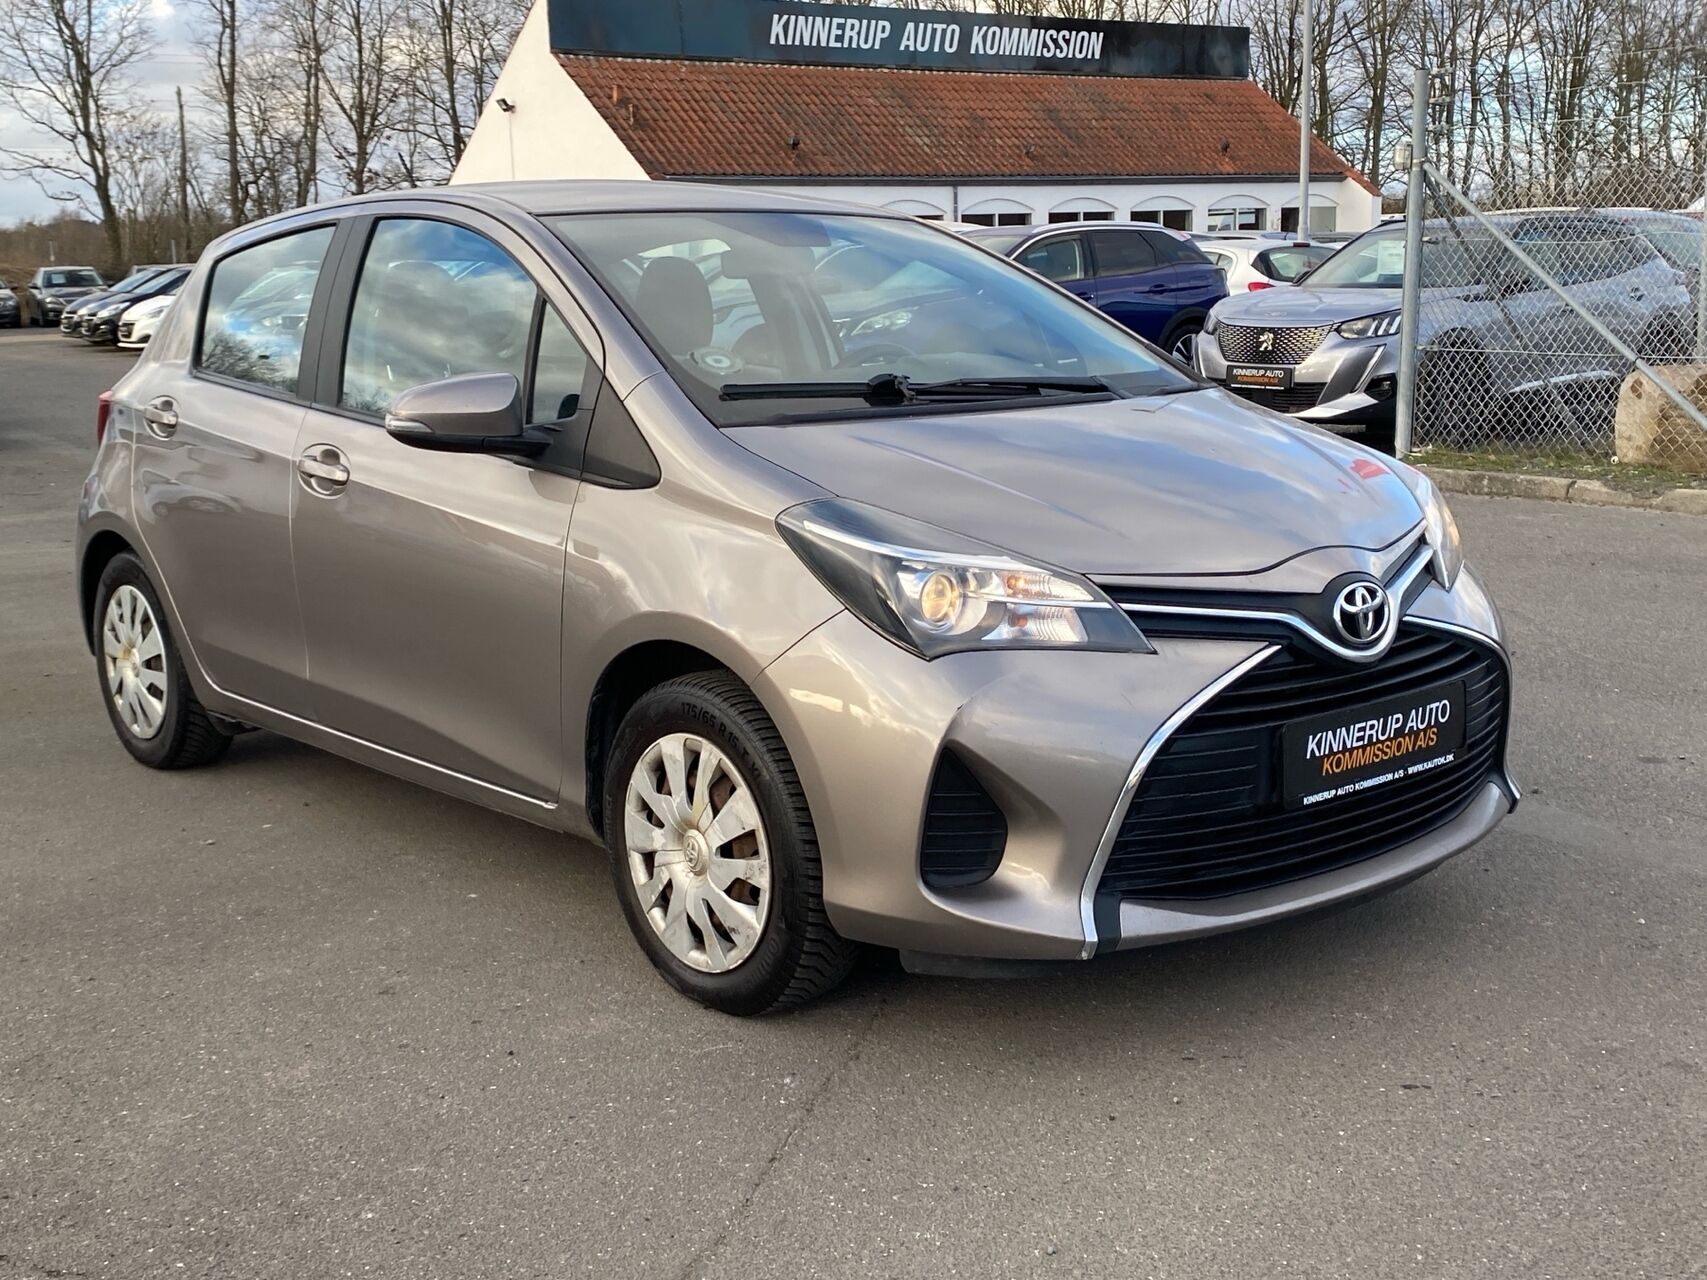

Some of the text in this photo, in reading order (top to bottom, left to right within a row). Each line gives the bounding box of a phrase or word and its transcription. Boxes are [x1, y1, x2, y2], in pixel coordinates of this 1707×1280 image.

[769, 14, 1105, 60] KINNERUP AUTO KOMMISSION
[1265, 370, 1284, 378] AUTO
[680, 702, 716, 728] 175/65
[719, 722, 727, 737] R
[728, 732, 739, 748] 15
[1306, 700, 1450, 759] KINNERUP AUTO
[1322, 727, 1438, 776] KOMMISSION A/S
[1303, 788, 1336, 805] KINNERUP
[1337, 784, 1354, 795] AUTO
[1355, 771, 1394, 790] KOMMISSION
[1393, 769, 1404, 780] A/S
